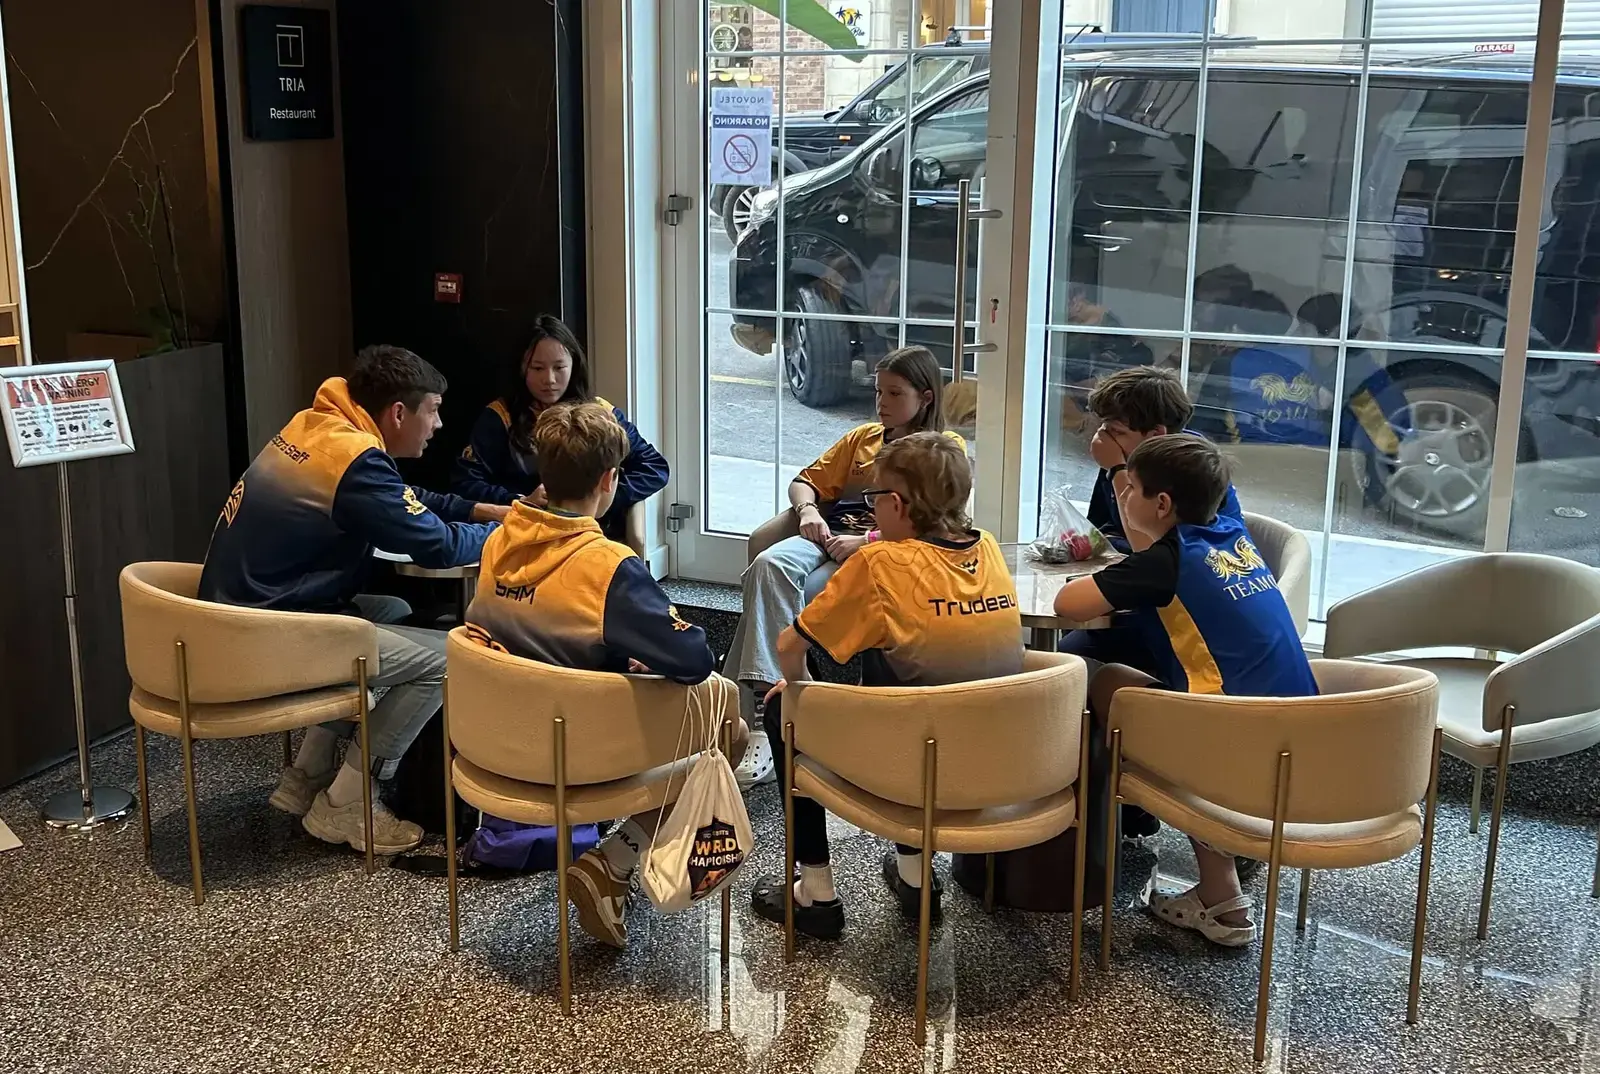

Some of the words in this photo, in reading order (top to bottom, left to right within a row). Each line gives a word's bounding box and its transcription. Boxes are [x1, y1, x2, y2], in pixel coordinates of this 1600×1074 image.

[1475, 44, 1515, 52] GARAGE
[279, 77, 306, 92] TRIA
[270, 107, 316, 119] Restaurant
[284, 444, 310, 465] Staff
[495, 580, 536, 605] SAM
[928, 593, 1016, 616] Trudeau
[614, 829, 639, 853] FILA
